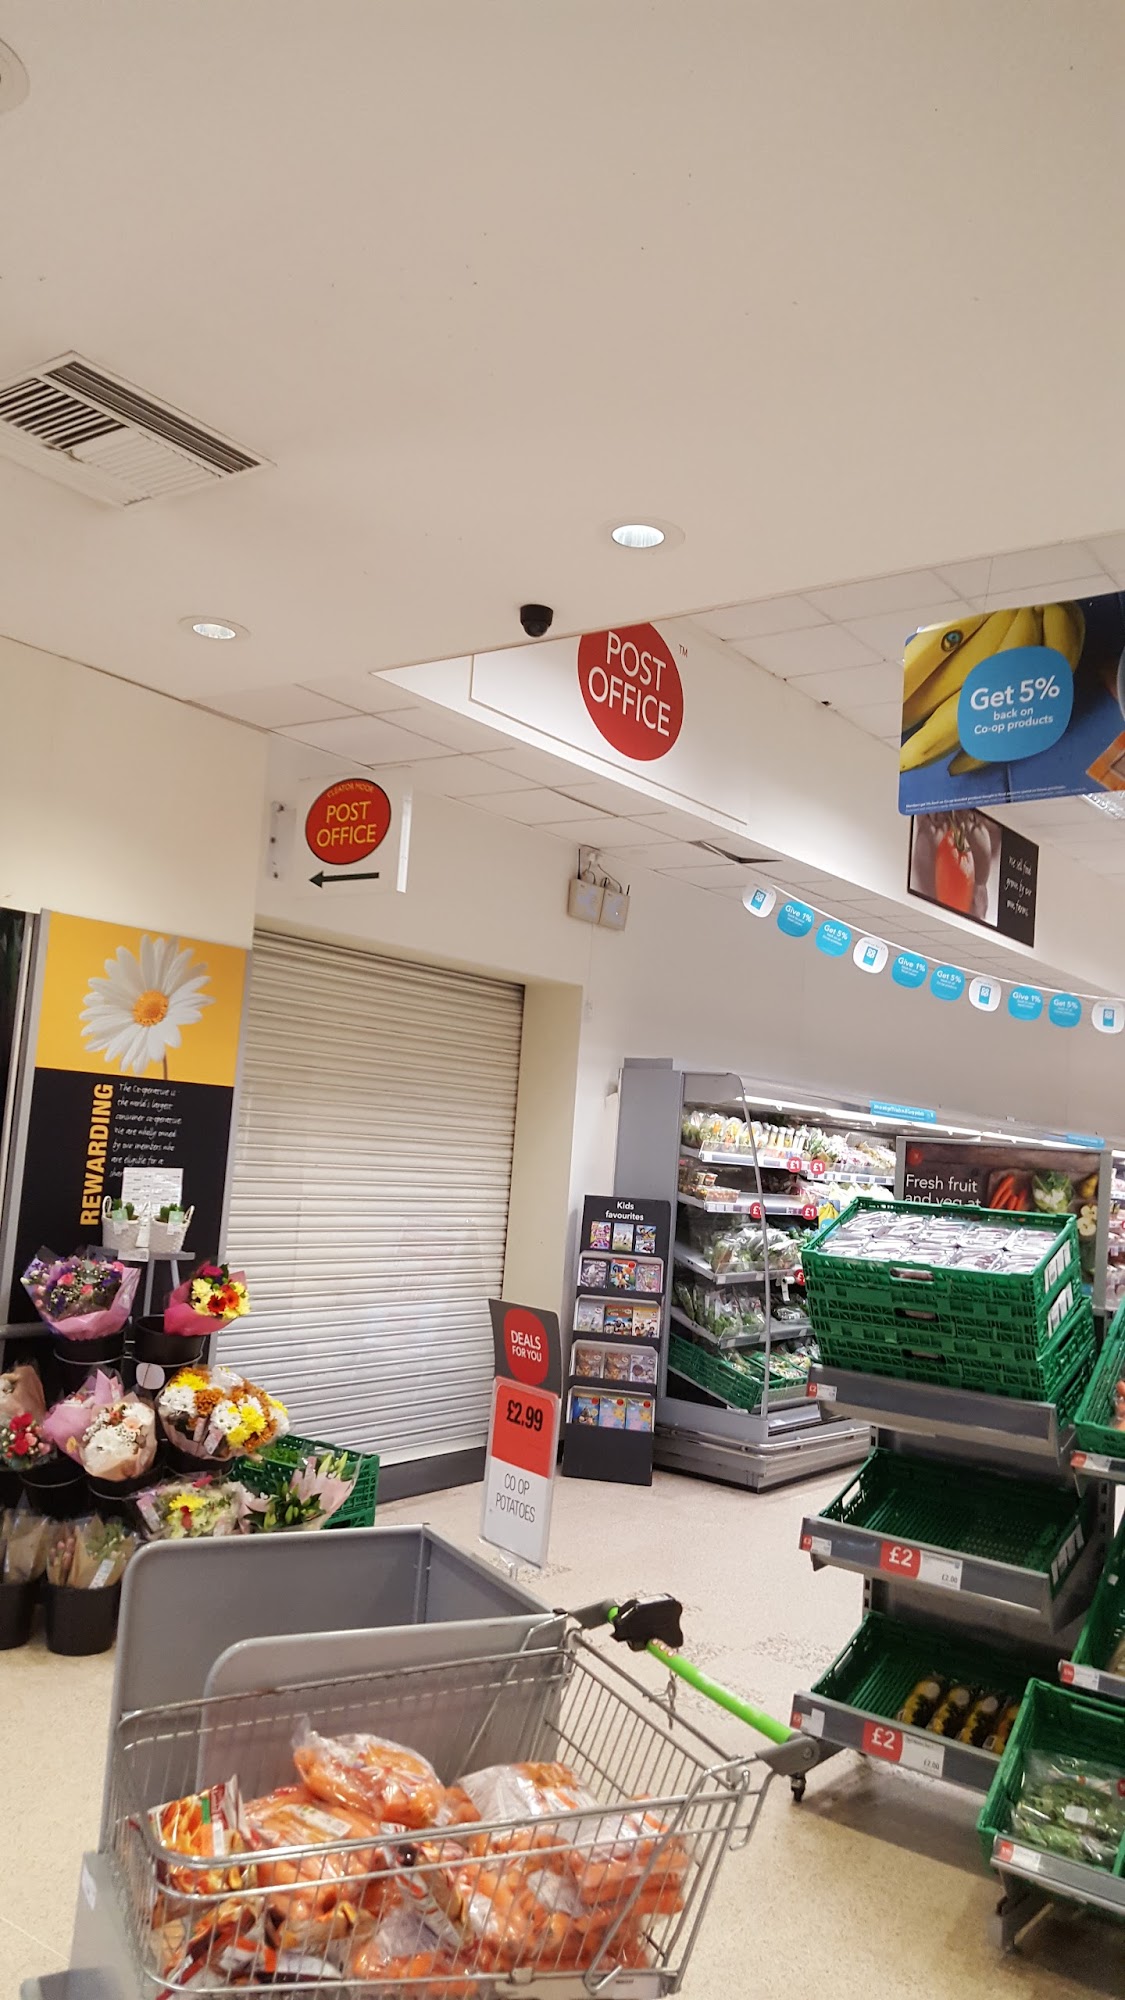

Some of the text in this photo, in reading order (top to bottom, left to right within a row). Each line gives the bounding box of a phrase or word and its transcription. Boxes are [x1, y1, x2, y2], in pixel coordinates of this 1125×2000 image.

[678, 644, 688, 657] TM
[606, 631, 666, 692] POST
[970, 675, 1060, 711] Get 5%
[588, 666, 671, 737] OFFICE
[993, 707, 1034, 720] back on
[974, 715, 1053, 735] Co-op products
[326, 801, 371, 823] POST
[316, 824, 377, 847] OFFICE
[785, 904, 800, 917] Give
[802, 912, 812, 923] 1%
[824, 924, 837, 935] Get
[837, 929, 848, 940] 5%
[898, 957, 914, 968] Give
[916, 962, 926, 972] 1%
[936, 970, 962, 983] Get 5%
[1012, 991, 1041, 1003] Give 1%
[1053, 998, 1078, 1009] Get 5%
[119, 1082, 131, 1093] The
[117, 1096, 128, 1107] the
[112, 1139, 122, 1153] by
[134, 1141, 162, 1151] members
[162, 1142, 175, 1151] who
[80, 1083, 114, 1226] REWARDING
[147, 1155, 157, 1165] for
[789, 1160, 800, 1169] £1
[812, 1162, 823, 1172] £1
[906, 1173, 978, 1193] Fresh fruit
[616, 1201, 635, 1210] Kids
[905, 1192, 932, 1204] and
[605, 1210, 644, 1221] favourites
[804, 1207, 815, 1217] £1
[510, 1329, 542, 1351] DEALS
[511, 1346, 542, 1363] FOR YOU
[506, 1398, 543, 1433] £2.99
[504, 1472, 530, 1498] CO OP
[495, 1491, 536, 1524] POTATOES
[888, 1546, 913, 1568] £2
[941, 1573, 958, 1584] £2.00
[871, 1726, 896, 1750] £2
